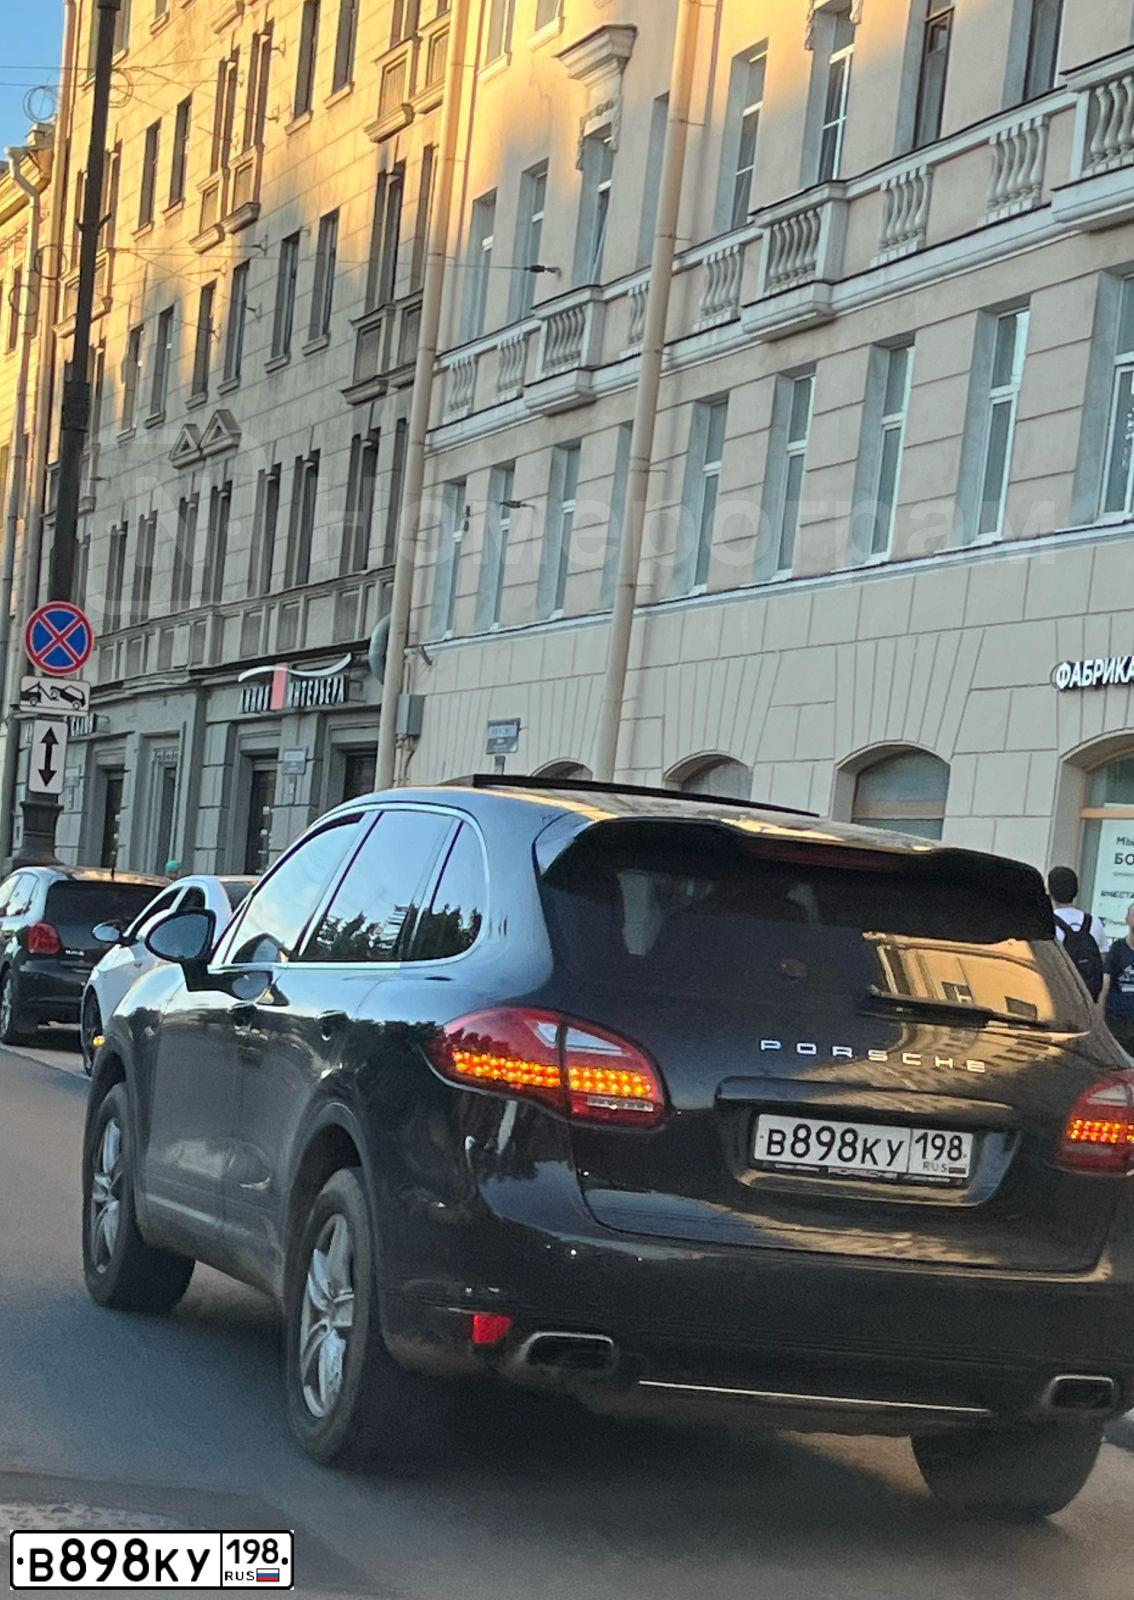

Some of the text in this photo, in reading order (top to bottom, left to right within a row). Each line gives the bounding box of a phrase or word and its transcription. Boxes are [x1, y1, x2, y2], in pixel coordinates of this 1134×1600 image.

[761, 1039, 986, 1074] PORSCHE
[766, 1123, 964, 1168] В898КУ 198
[922, 1161, 949, 1174] RUS
